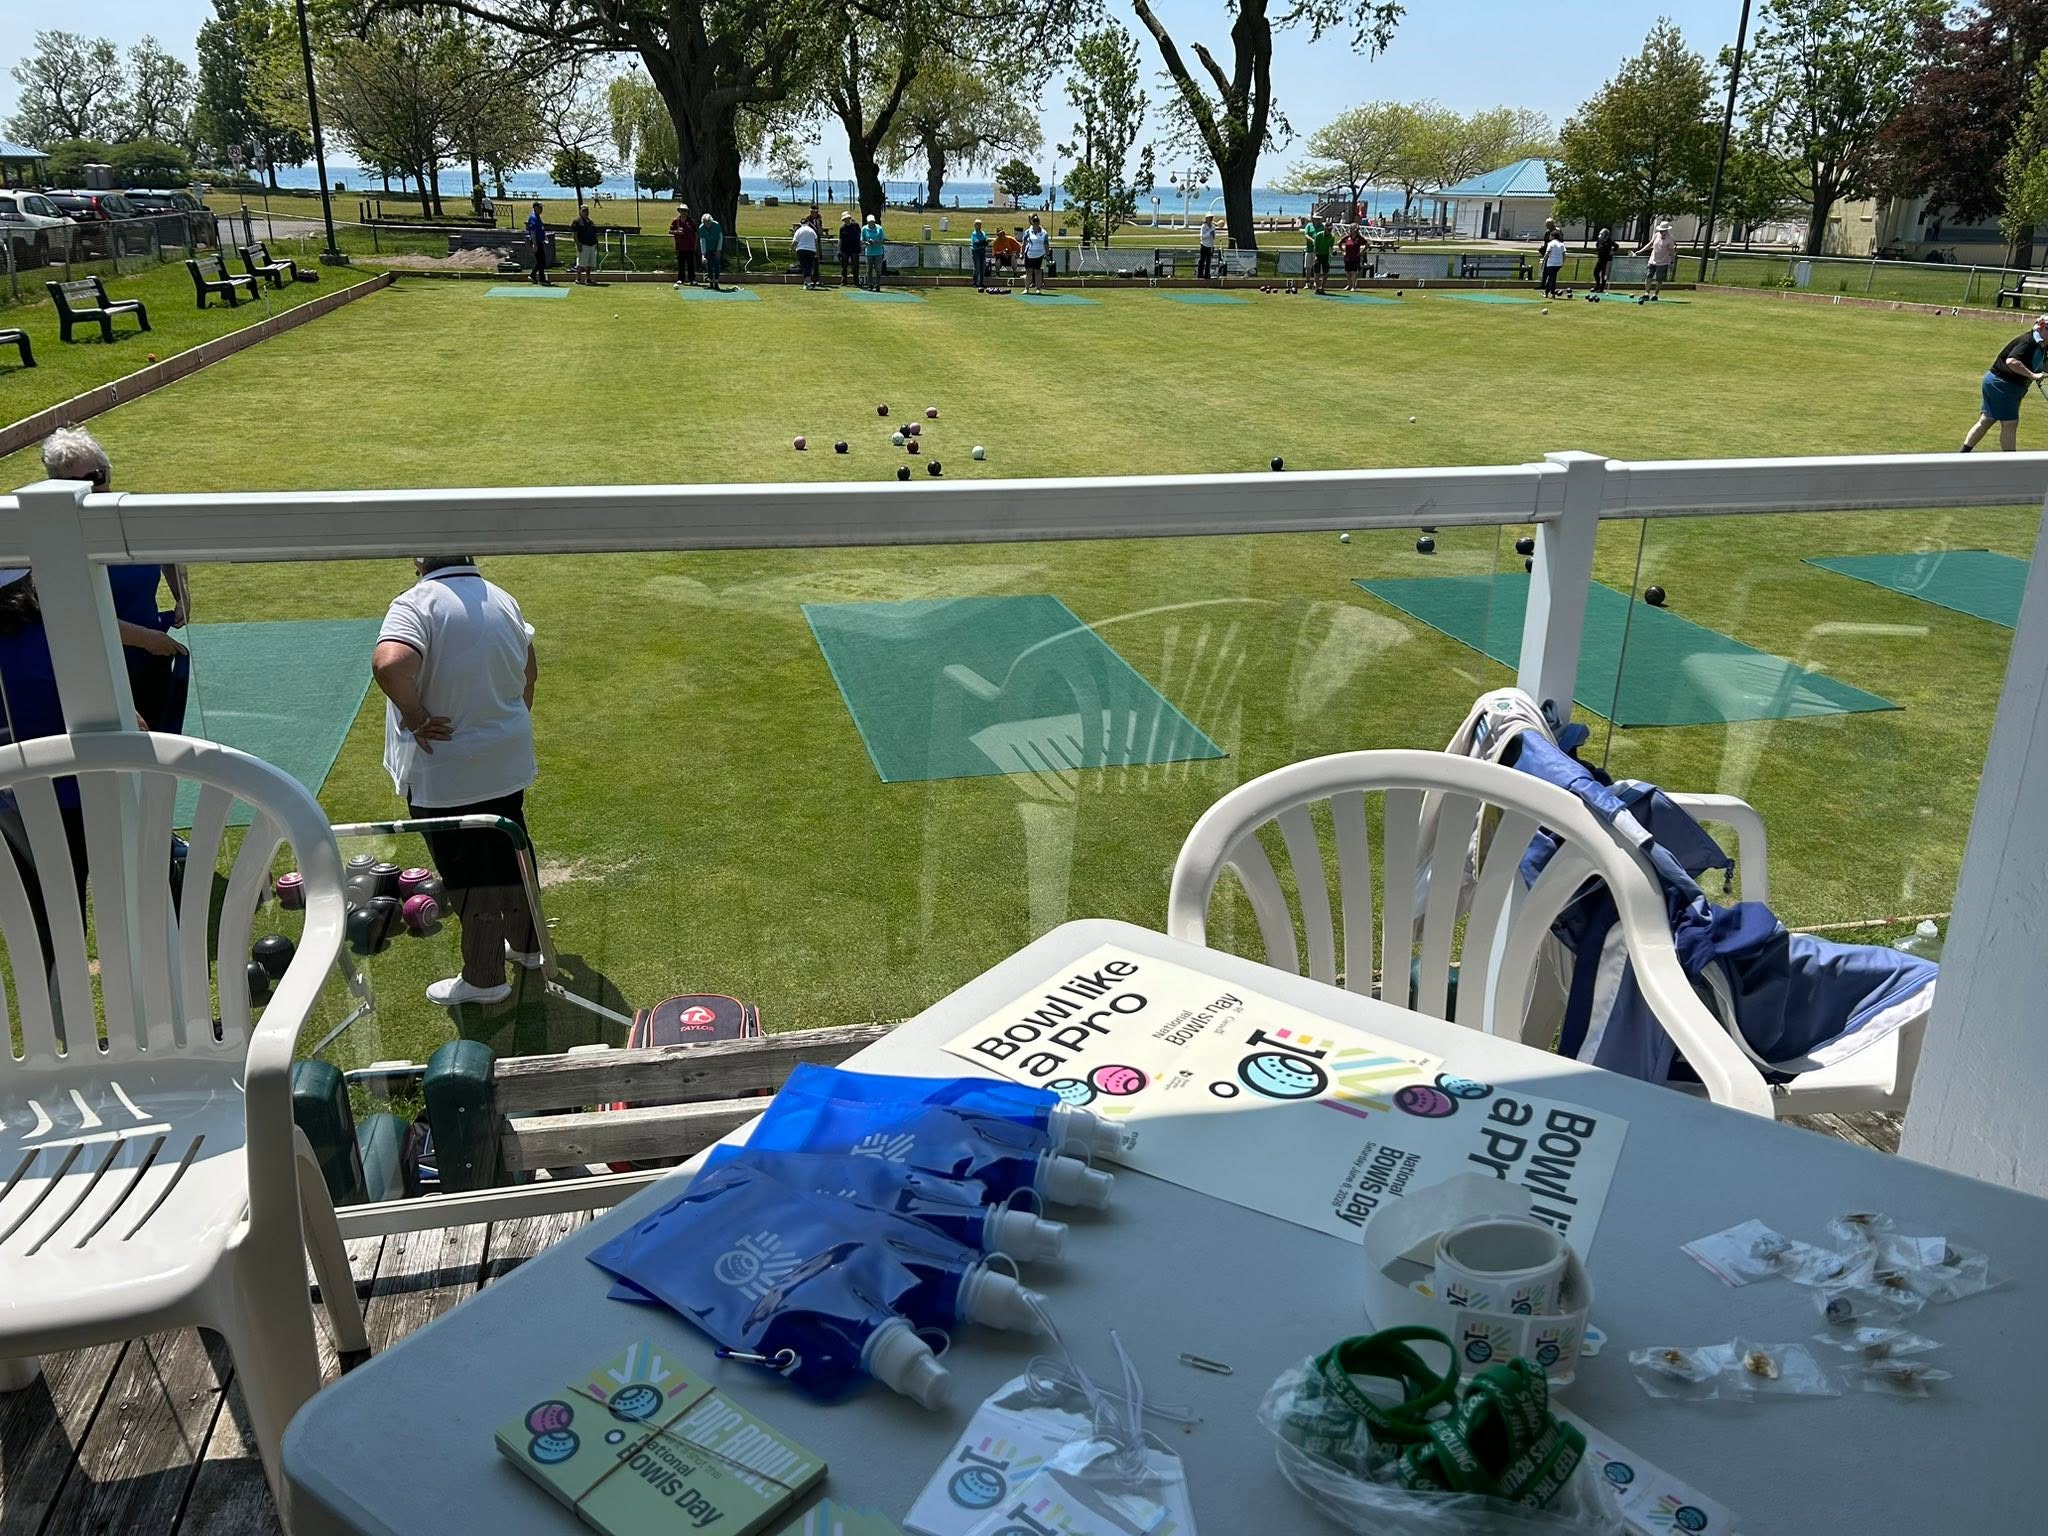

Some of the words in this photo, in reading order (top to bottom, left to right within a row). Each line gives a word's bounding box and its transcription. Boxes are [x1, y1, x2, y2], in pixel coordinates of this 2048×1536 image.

[972, 994, 1084, 1061] Bowl
[1060, 960, 1138, 1000] like
[1152, 1010, 1194, 1039] National
[1164, 1012, 1214, 1046] Bowls
[1018, 1052, 1069, 1077] a
[1048, 993, 1148, 1052] Pro
[1487, 1097, 1533, 1127] a
[1360, 1146, 1406, 1193] Bowls
[1388, 1152, 1421, 1198] National
[1521, 1108, 1597, 1205] Bowl
[1335, 1193, 1379, 1228] Day
[638, 1433, 696, 1478] National
[674, 1487, 725, 1529] Day
